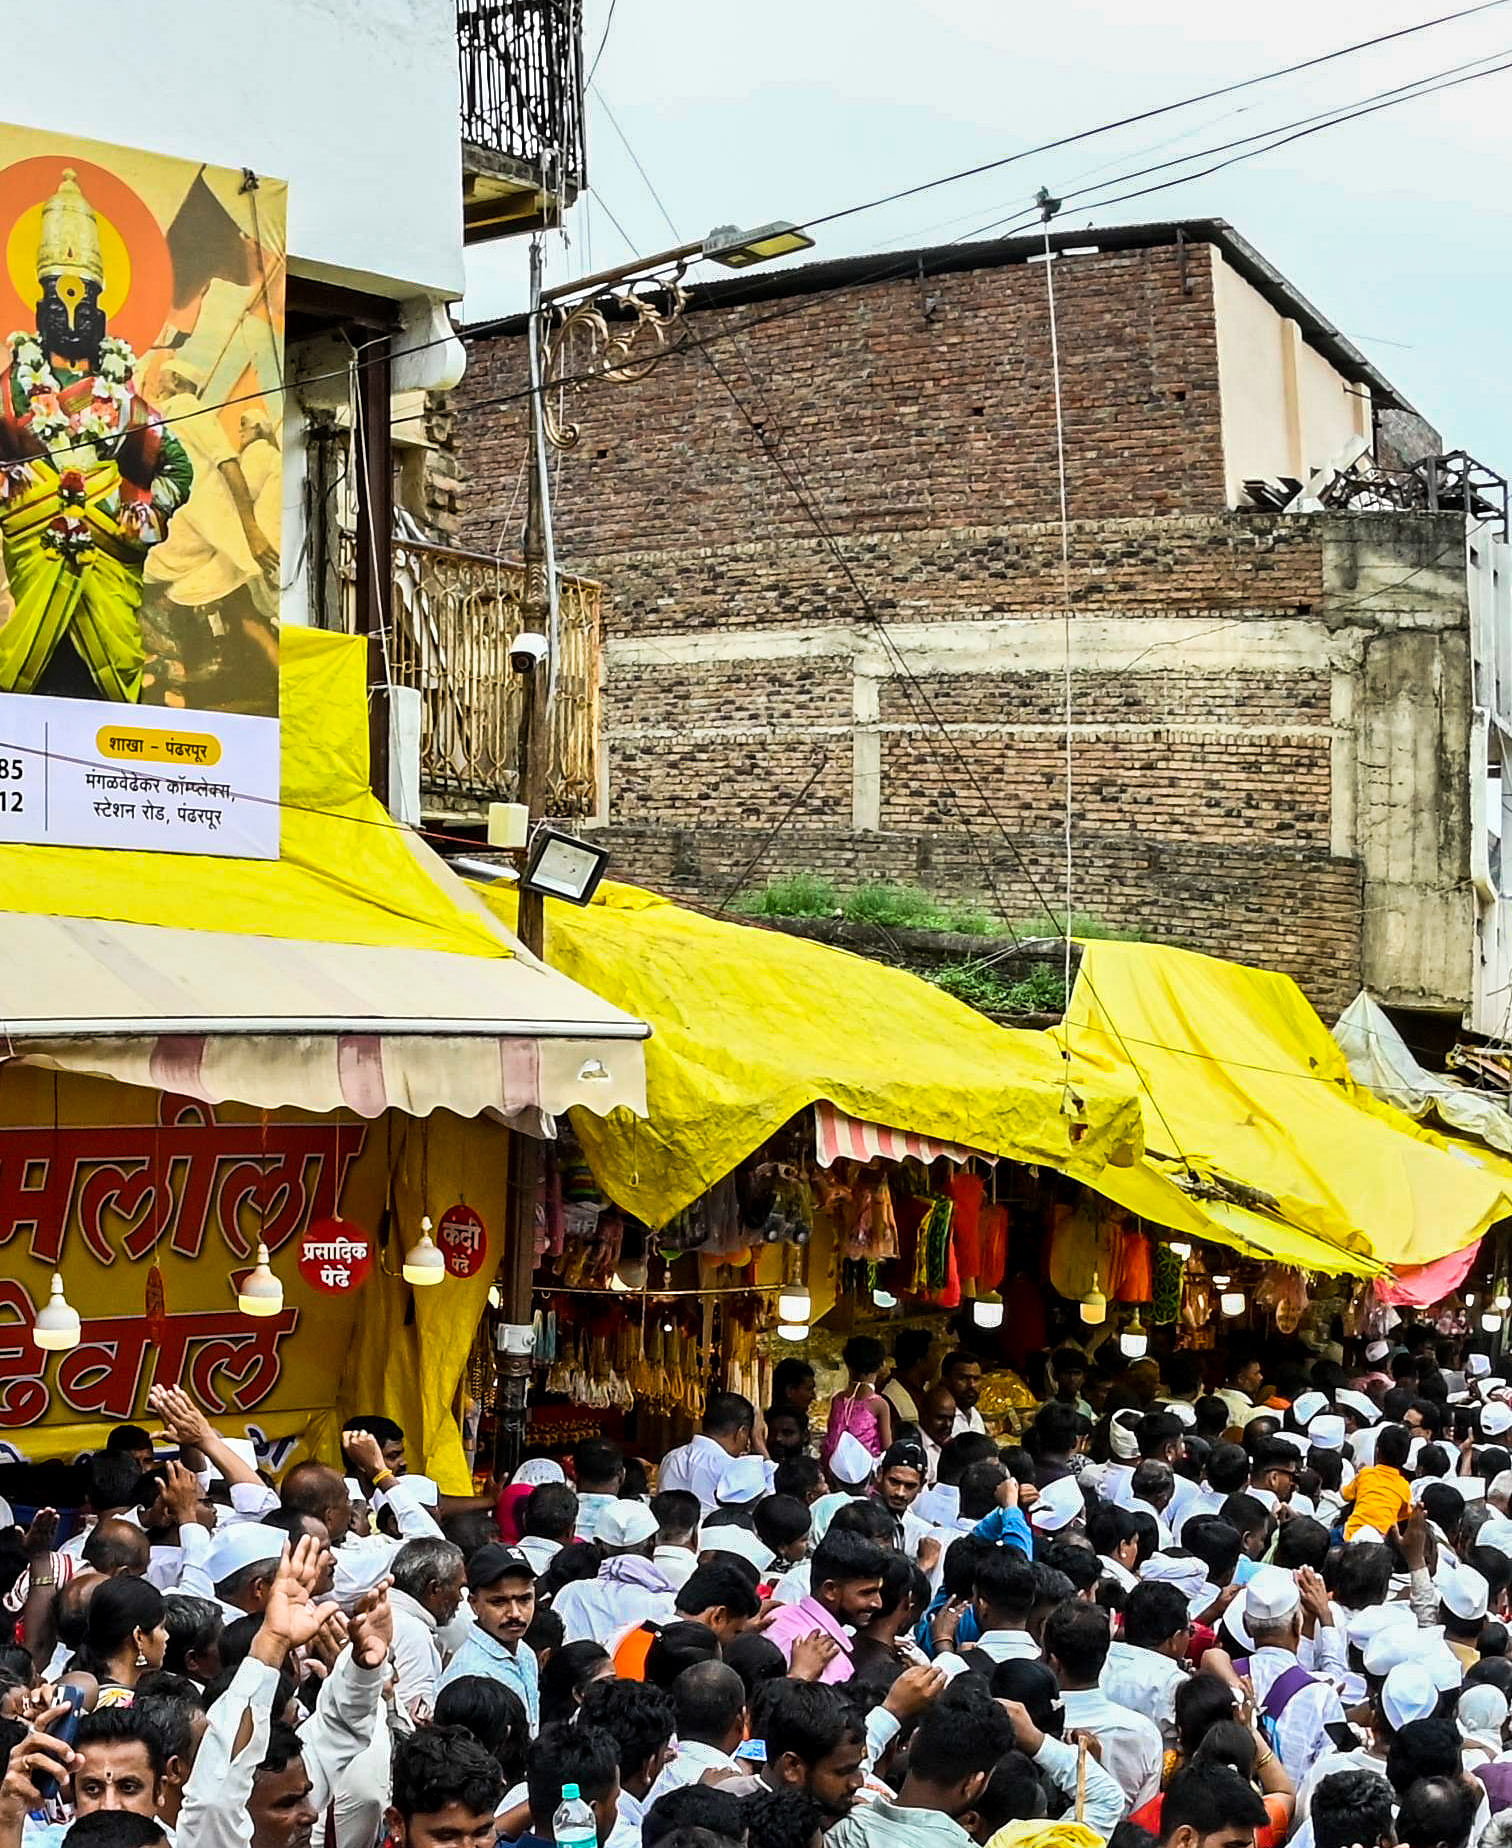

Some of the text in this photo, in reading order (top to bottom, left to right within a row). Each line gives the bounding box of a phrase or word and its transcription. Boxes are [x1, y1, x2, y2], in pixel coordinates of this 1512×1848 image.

[109, 737, 144, 753] शाखा
[166, 739, 208, 763] पंढरपूर
[86, 770, 161, 795] मंगळवेढेकर
[93, 801, 222, 830] स्टेशन रोड, पंढरपूर
[302, 1236, 368, 1264] प्रसादिक
[320, 1264, 350, 1287] पेढे
[451, 1253, 470, 1274] पेढे
